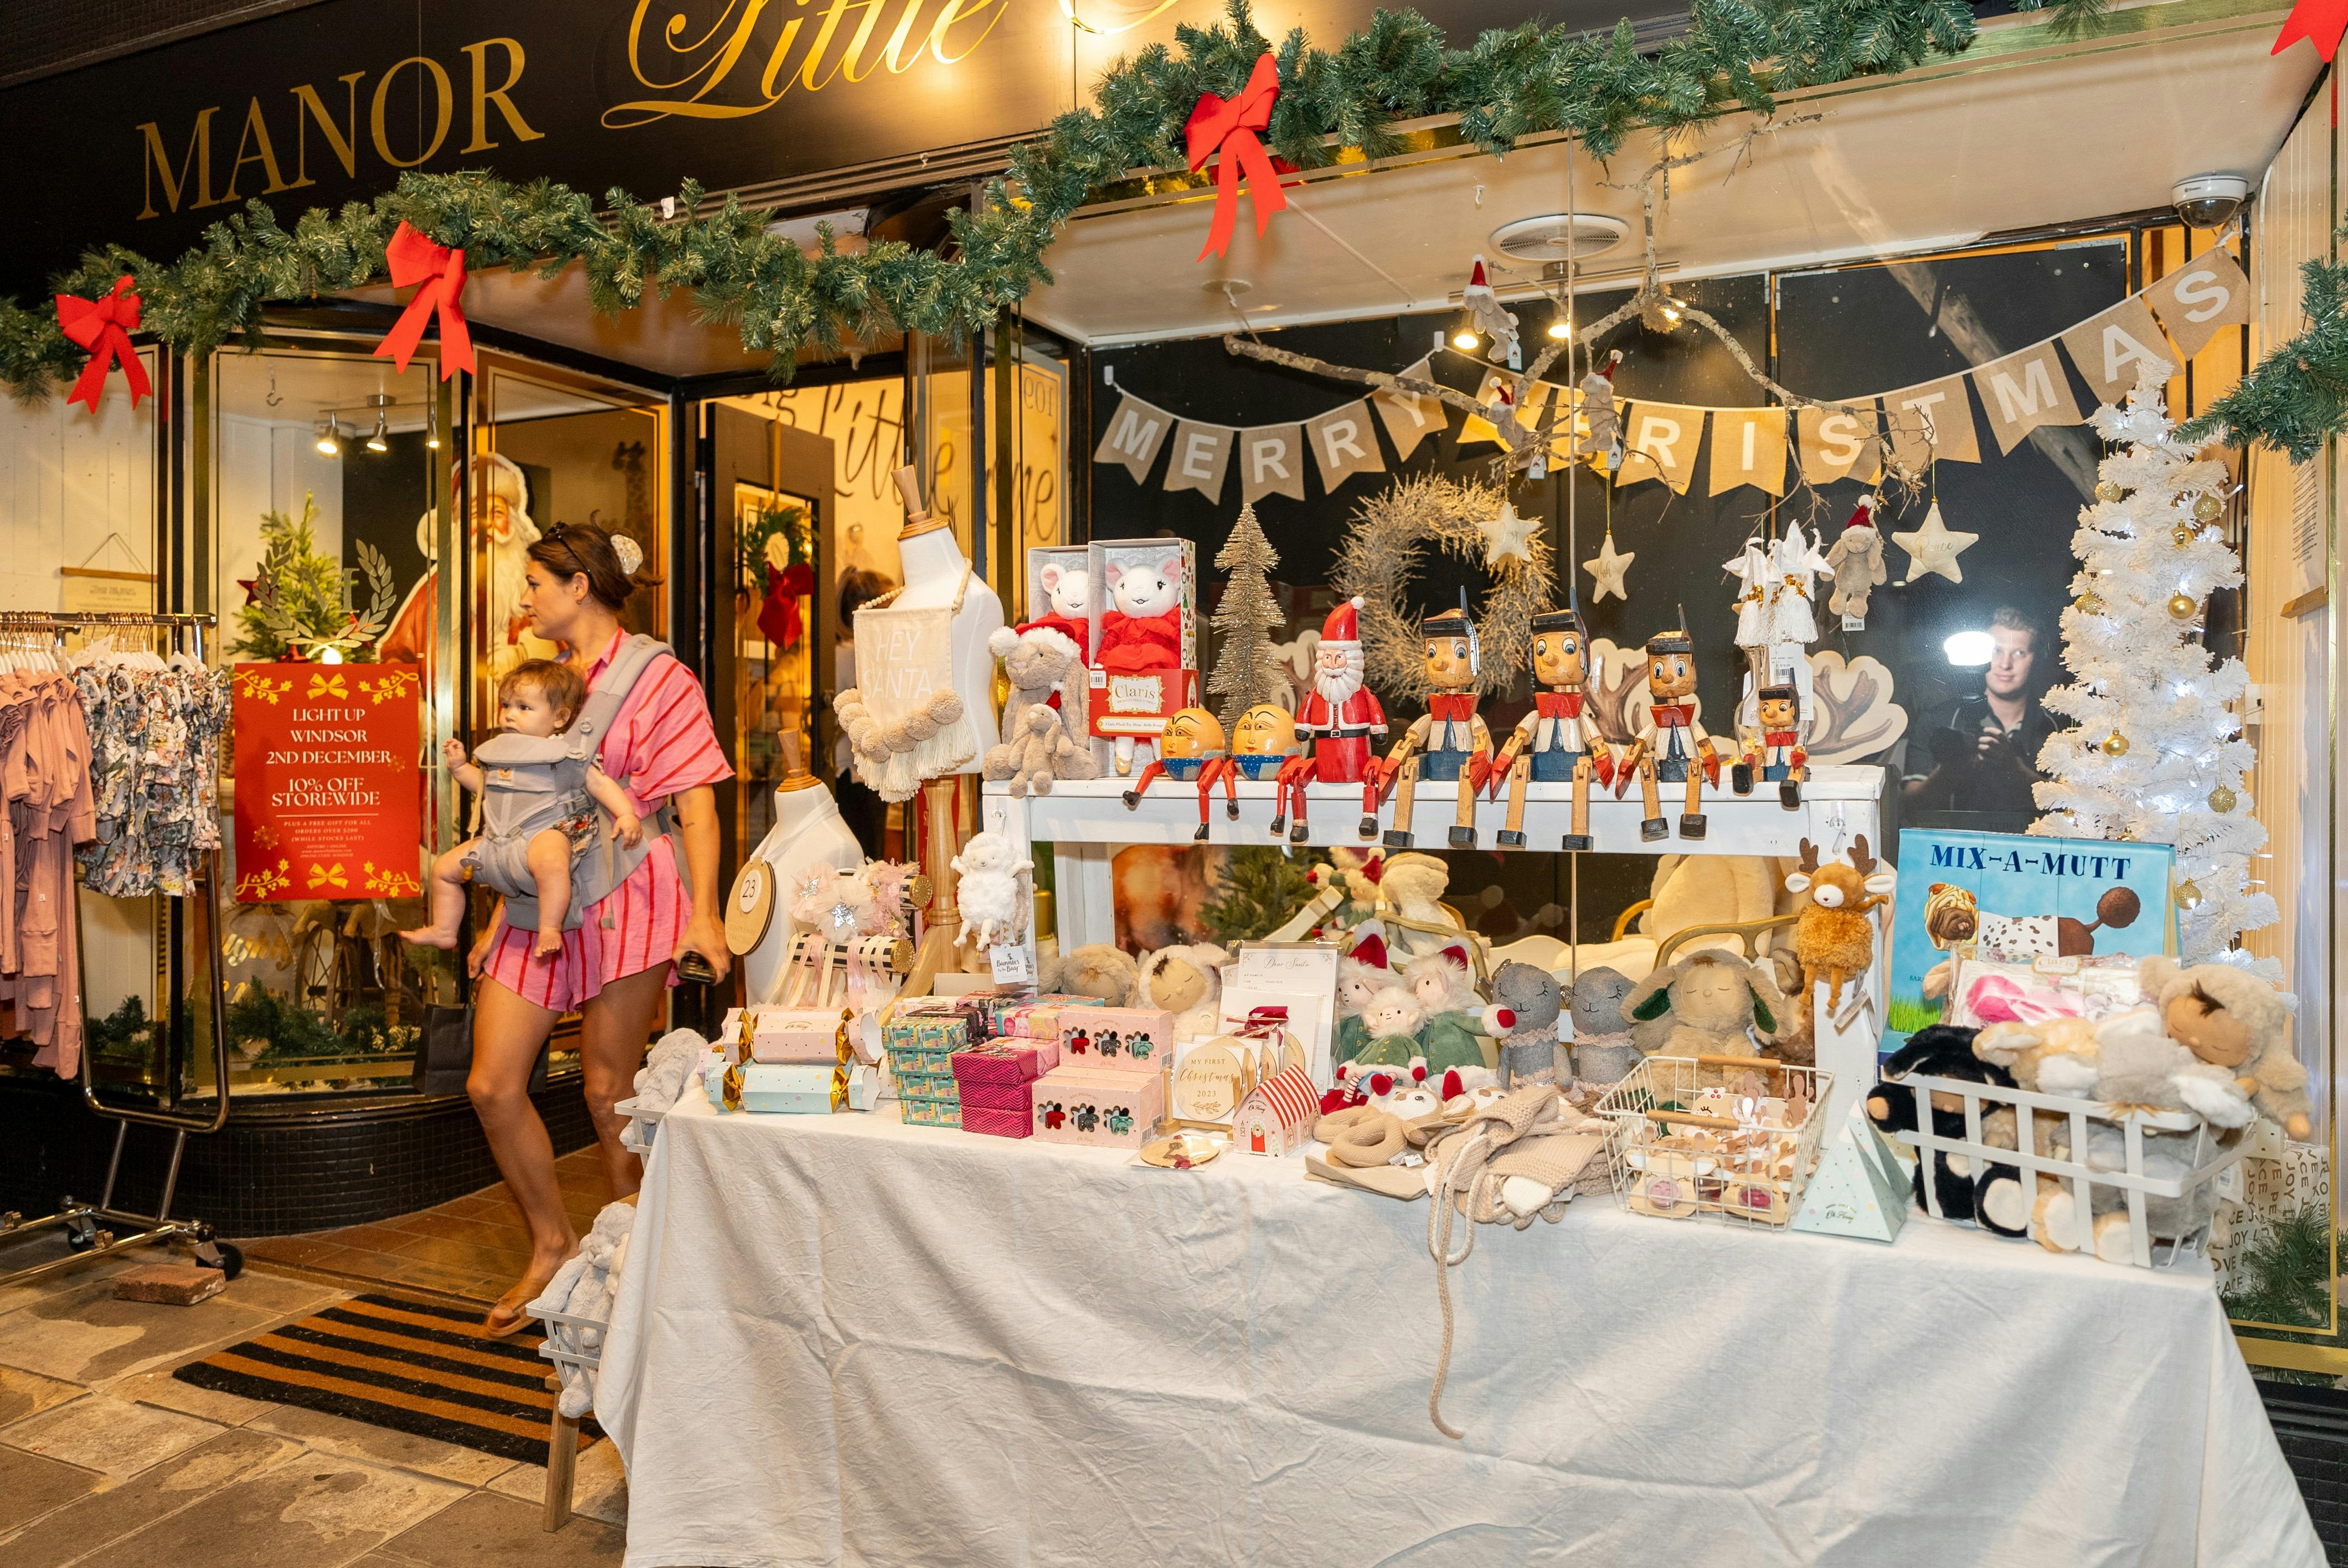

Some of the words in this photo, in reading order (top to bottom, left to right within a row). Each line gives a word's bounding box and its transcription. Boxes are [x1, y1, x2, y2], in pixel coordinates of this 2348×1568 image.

[135, 37, 545, 221] MANOR
[601, 0, 1006, 128] Little
[1112, 390, 1426, 483] MERRY
[1487, 270, 2230, 468] RISTMAS
[876, 630, 922, 661] HEY
[862, 667, 934, 700] SANTA
[1115, 684, 1156, 699] Claris
[293, 709, 341, 721] LIGHT
[344, 709, 365, 721] UP
[290, 729, 367, 742] WINDSOR
[266, 751, 298, 764] 2ND
[303, 750, 391, 764] DECEMBER
[289, 777, 323, 792] 10%
[327, 777, 364, 792] OFF
[271, 791, 380, 807] STOREWIDE
[1930, 844, 2131, 880] MIX-A-MUTT
[742, 879, 756, 898] 23
[1264, 956, 1284, 969] Dear
[1286, 957, 1309, 969] Santa
[1180, 1068, 1233, 1084] Christmas
[2284, 1162, 2295, 1200] JOY
[2229, 1230, 2248, 1248] JOY
